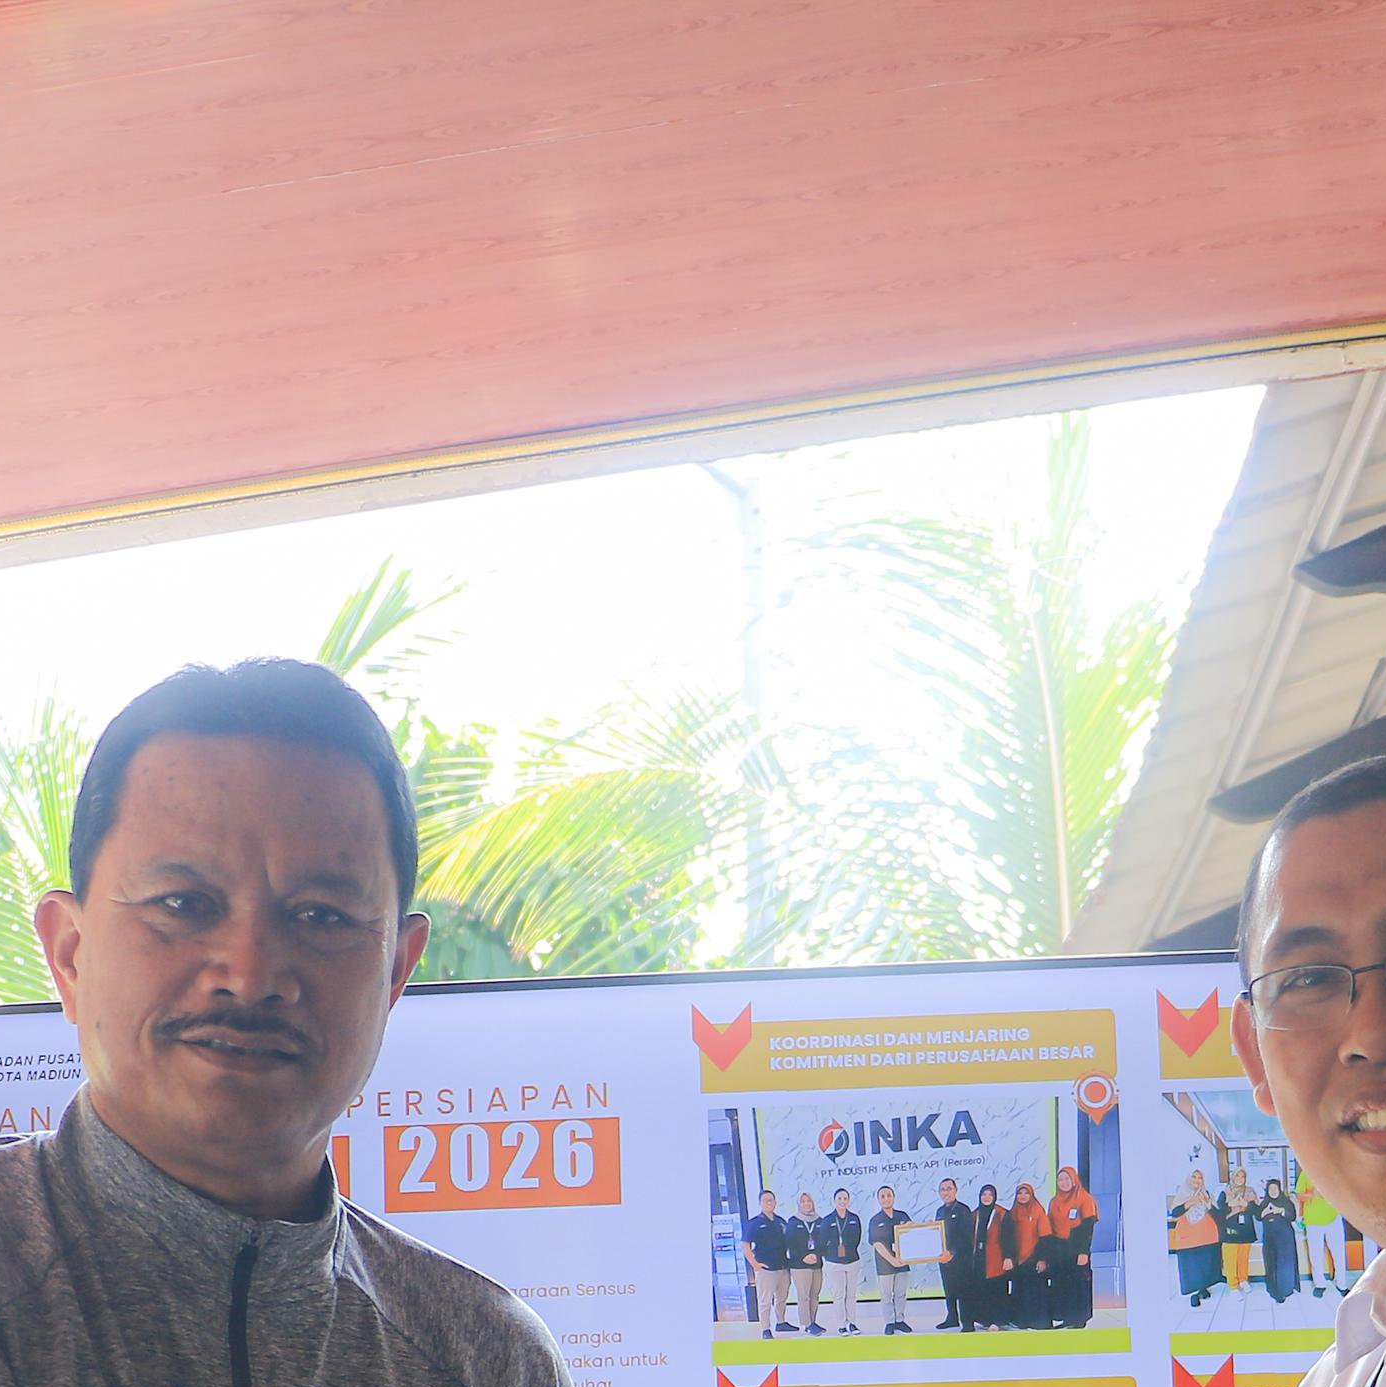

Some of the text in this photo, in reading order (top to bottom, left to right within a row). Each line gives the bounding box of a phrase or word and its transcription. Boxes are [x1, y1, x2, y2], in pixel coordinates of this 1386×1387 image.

[769, 1028, 1030, 1050] KOORDINASI DAN MENJARING
[37, 1053, 81, 1065] PUSAT
[770, 1045, 1095, 1070] KOMITMEN DARI PERUSAHAAN BESAR
[26, 1068, 81, 1081] MADIUN
[346, 1082, 607, 1118] PERSIAPAN
[853, 1110, 983, 1156] INKA
[398, 1120, 594, 1193] 2026
[821, 1156, 986, 1178] PT INDUSTRI KERETA API (Persero)
[576, 1283, 636, 1297] Sensus
[561, 1330, 623, 1348] rangka
[620, 1353, 668, 1367] untuk
